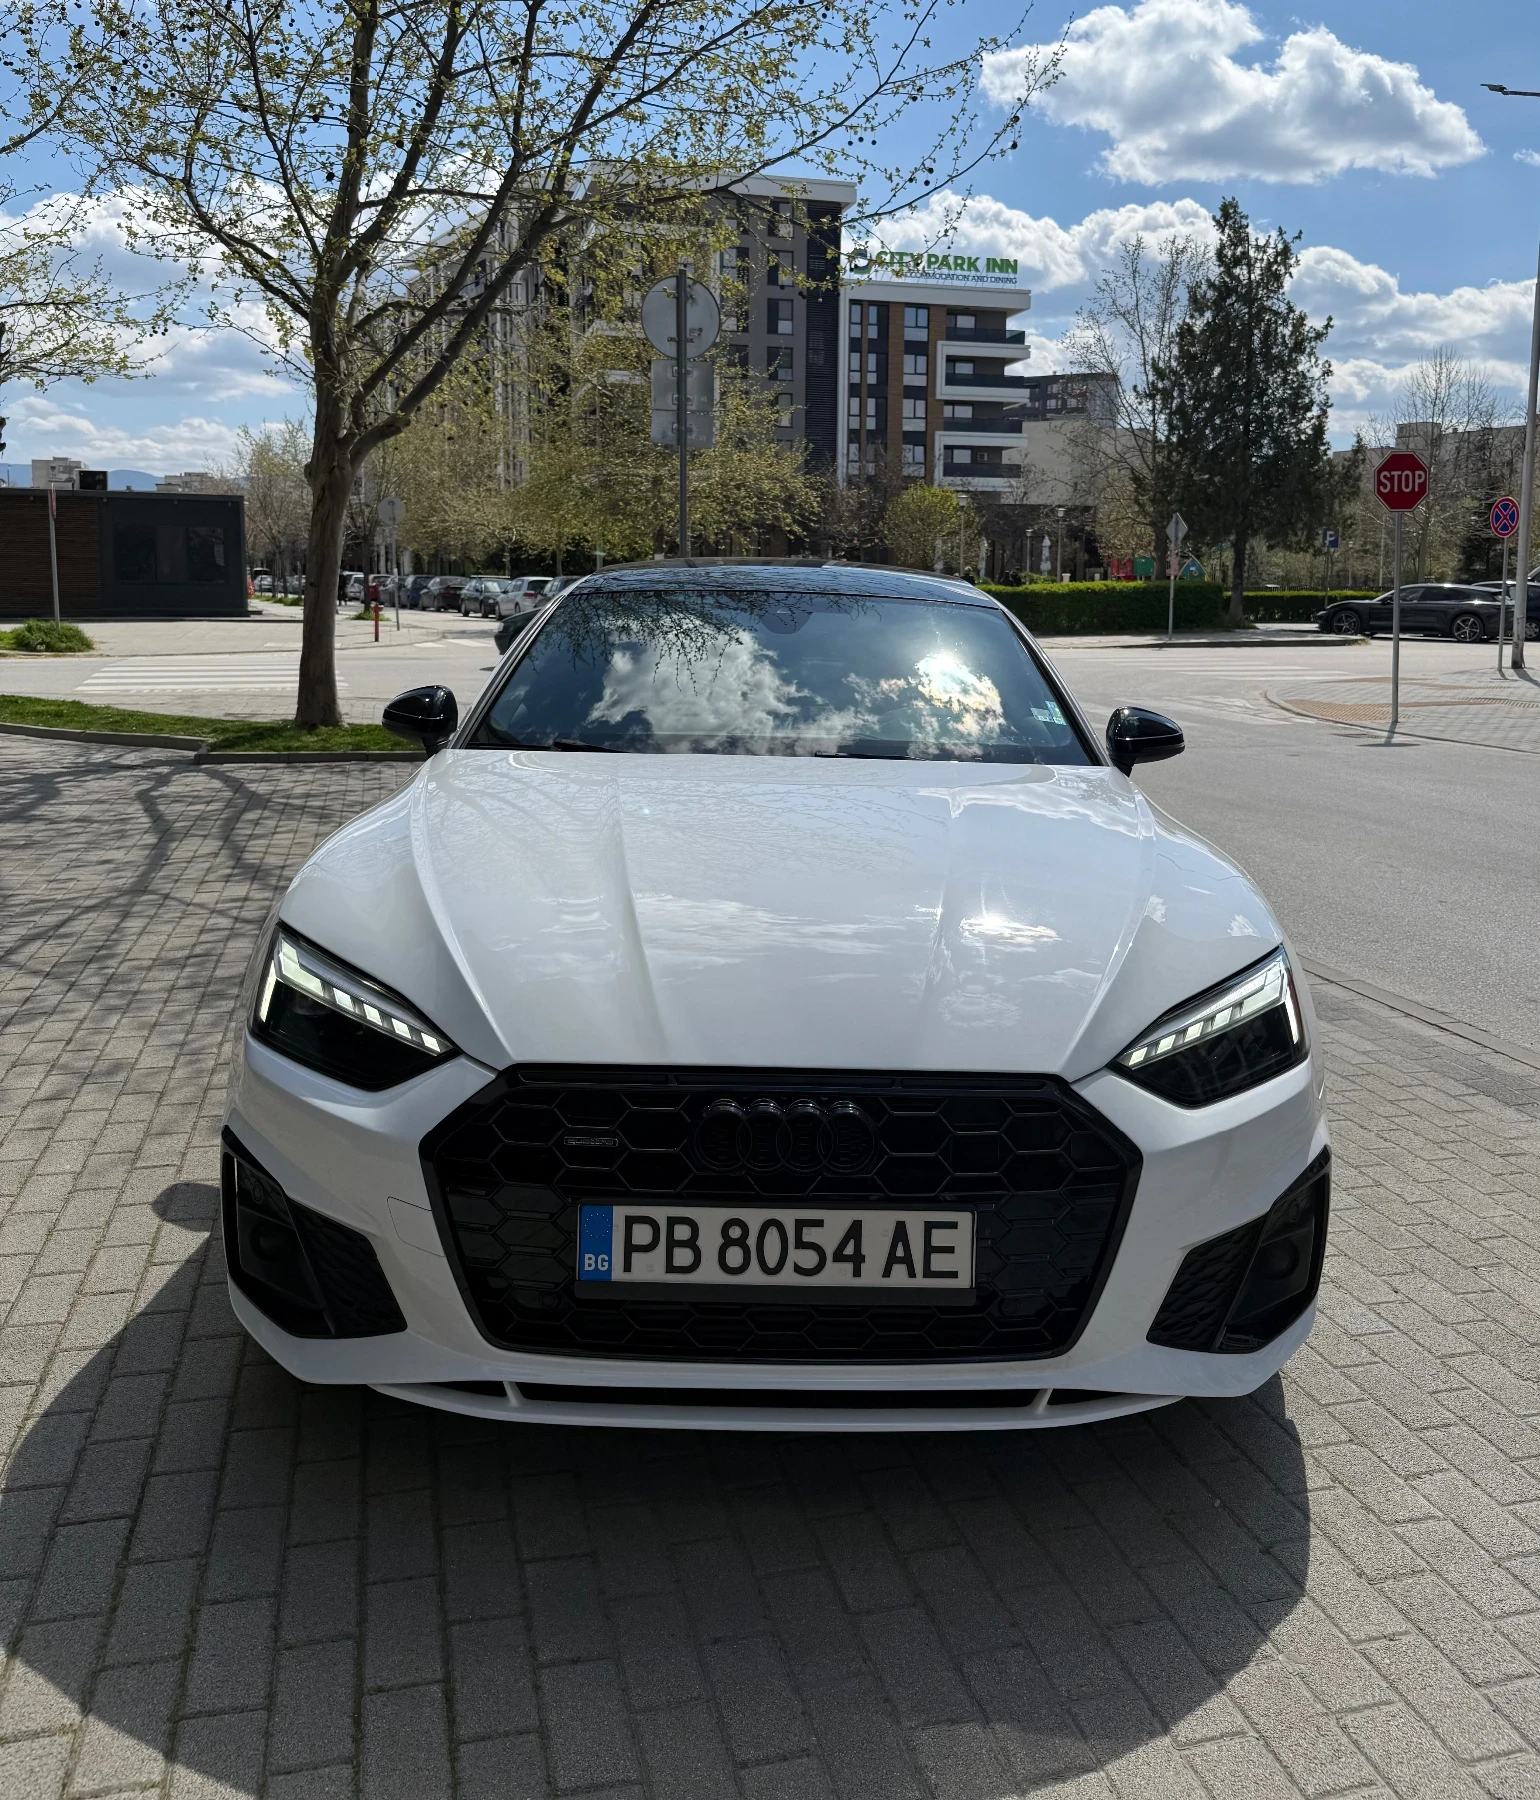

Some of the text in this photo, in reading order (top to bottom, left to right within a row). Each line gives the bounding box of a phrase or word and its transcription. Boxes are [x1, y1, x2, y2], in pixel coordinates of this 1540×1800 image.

[876, 251, 1018, 274] CITY PARK INN
[898, 272, 970, 282] CCOMMODATION
[971, 275, 988, 283] AND
[1379, 471, 1425, 493] STOP
[1326, 530, 1335, 546] P
[622, 1214, 960, 1280] PB 8054 AE
[584, 1253, 609, 1272] BG
